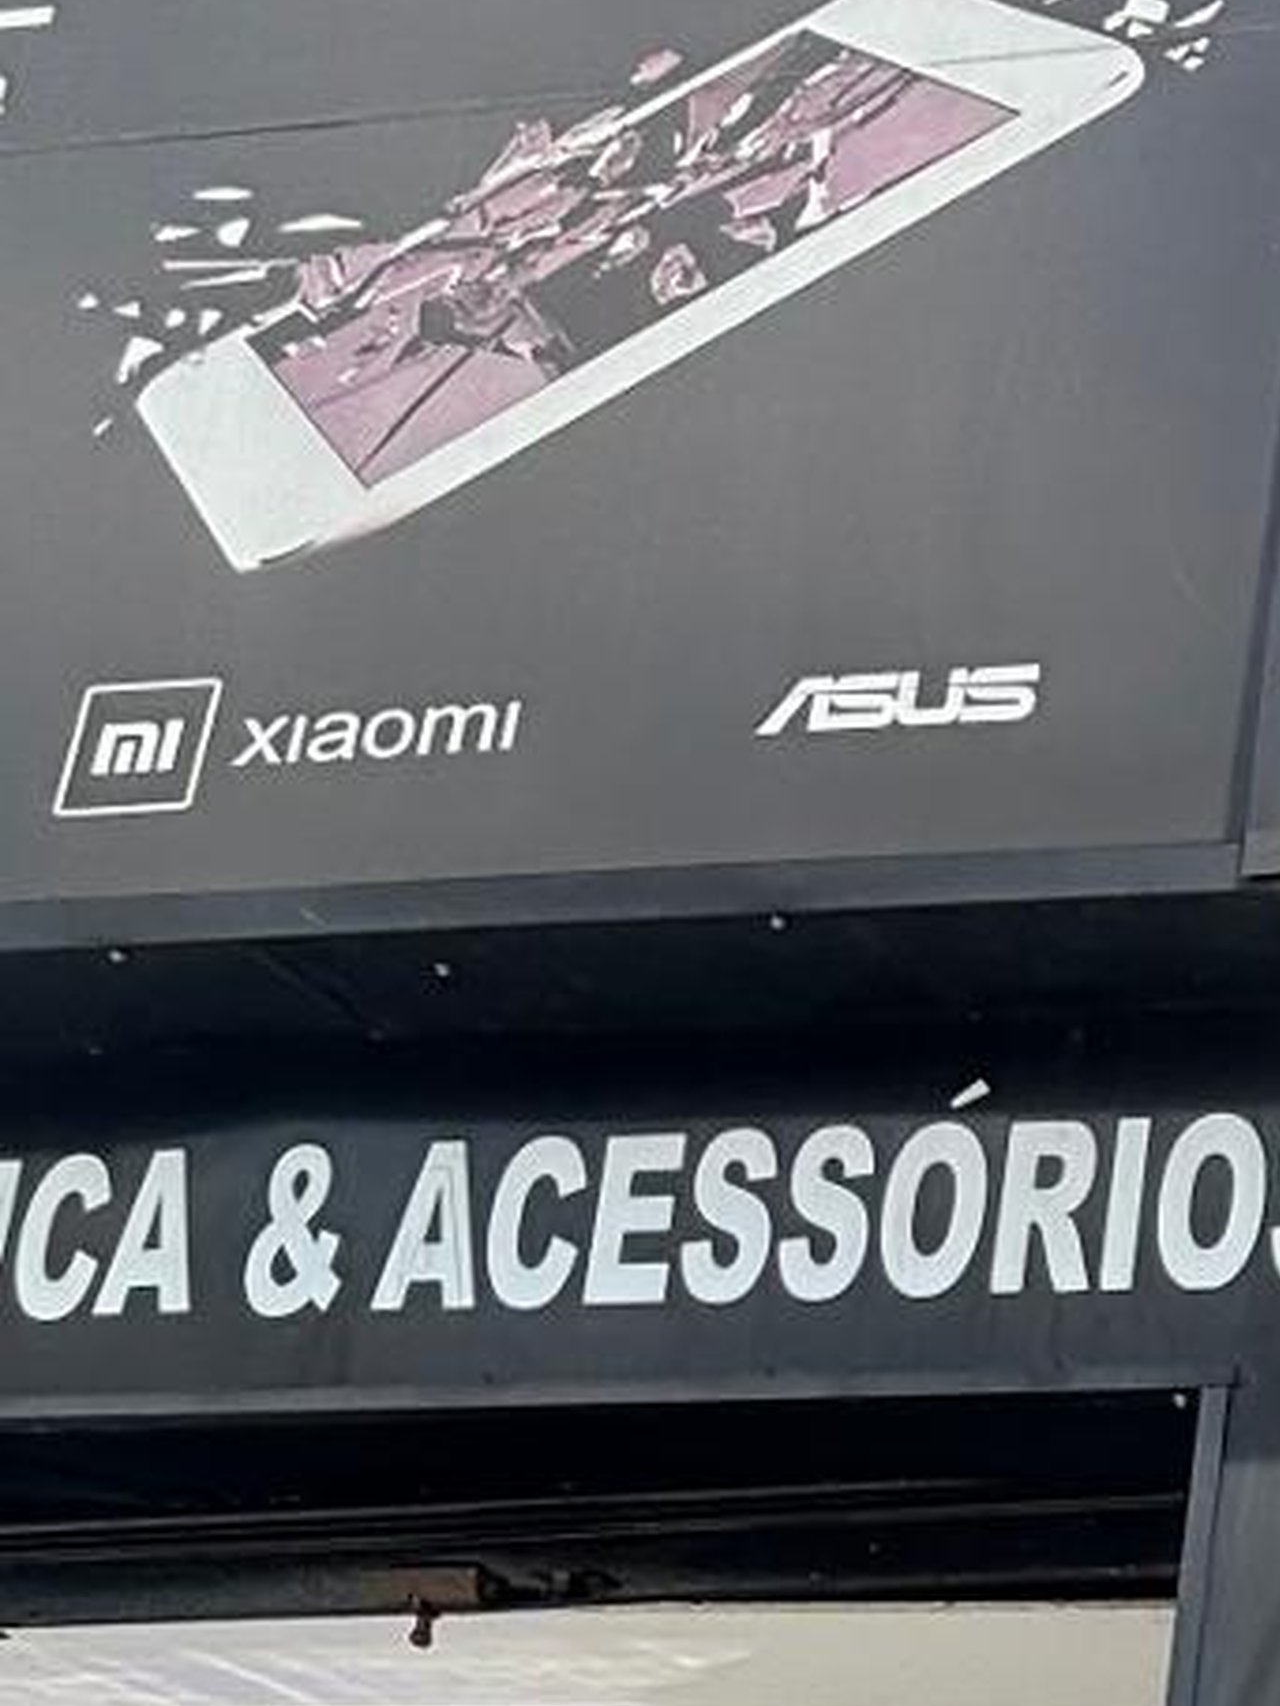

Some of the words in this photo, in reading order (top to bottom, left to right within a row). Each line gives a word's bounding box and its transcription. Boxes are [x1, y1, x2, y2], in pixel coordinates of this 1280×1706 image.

[231, 700, 521, 767] xiaomi
[755, 663, 1040, 736] ASUS
[0, 1149, 190, 1320] CA
[244, 1144, 341, 1317] &
